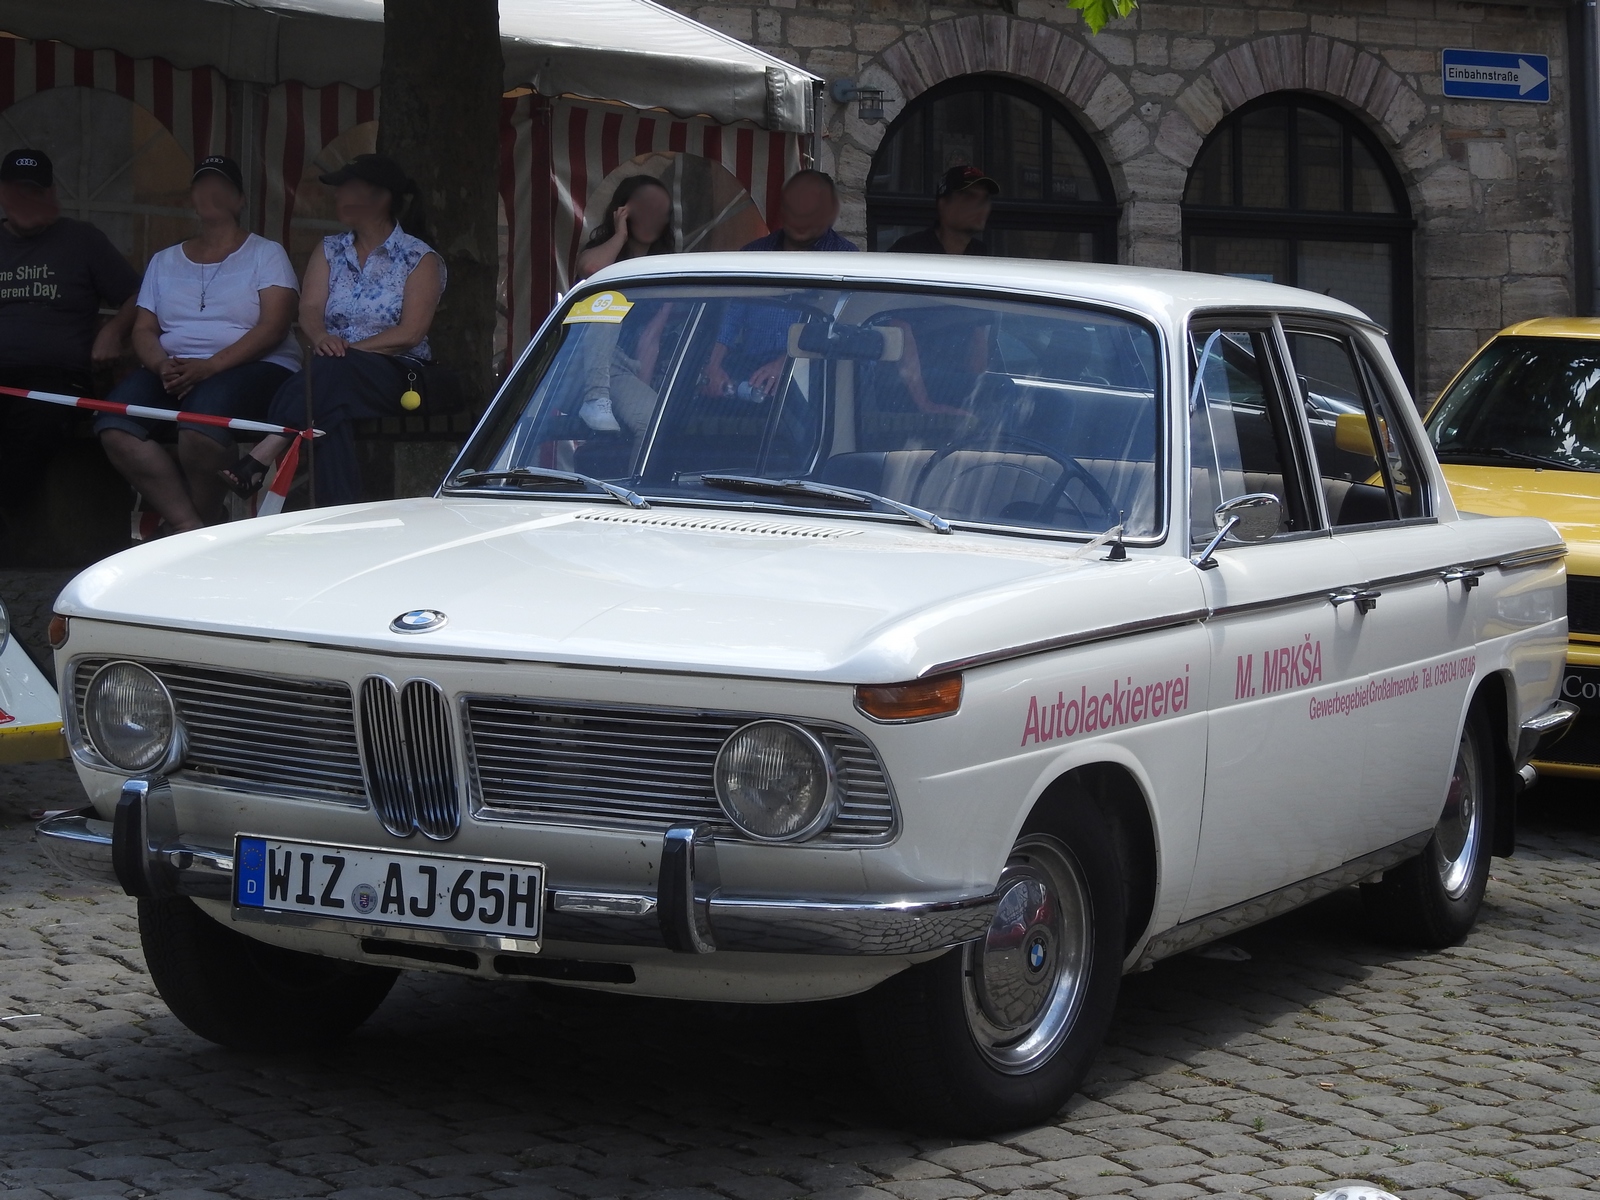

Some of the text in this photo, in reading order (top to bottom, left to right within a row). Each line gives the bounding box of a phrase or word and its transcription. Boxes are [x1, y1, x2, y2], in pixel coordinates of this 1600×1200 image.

[1448, 67, 1519, 81] Einbahnstraße
[16, 263, 55, 280] Shirt-
[33, 281, 62, 300] Day.
[594, 299, 610, 308] 35
[1235, 633, 1323, 700] M. MRKŠA
[1309, 688, 1369, 720] Gewerbegebiet
[1369, 671, 1419, 702] Großalmerode
[1422, 667, 1433, 690] Tel.
[1562, 674, 1600, 699] Co
[1021, 664, 1190, 747] Autolackiererei
[247, 879, 257, 894] D
[268, 848, 345, 908] WIZ
[380, 862, 438, 918] AJ
[450, 869, 537, 929] 65H
